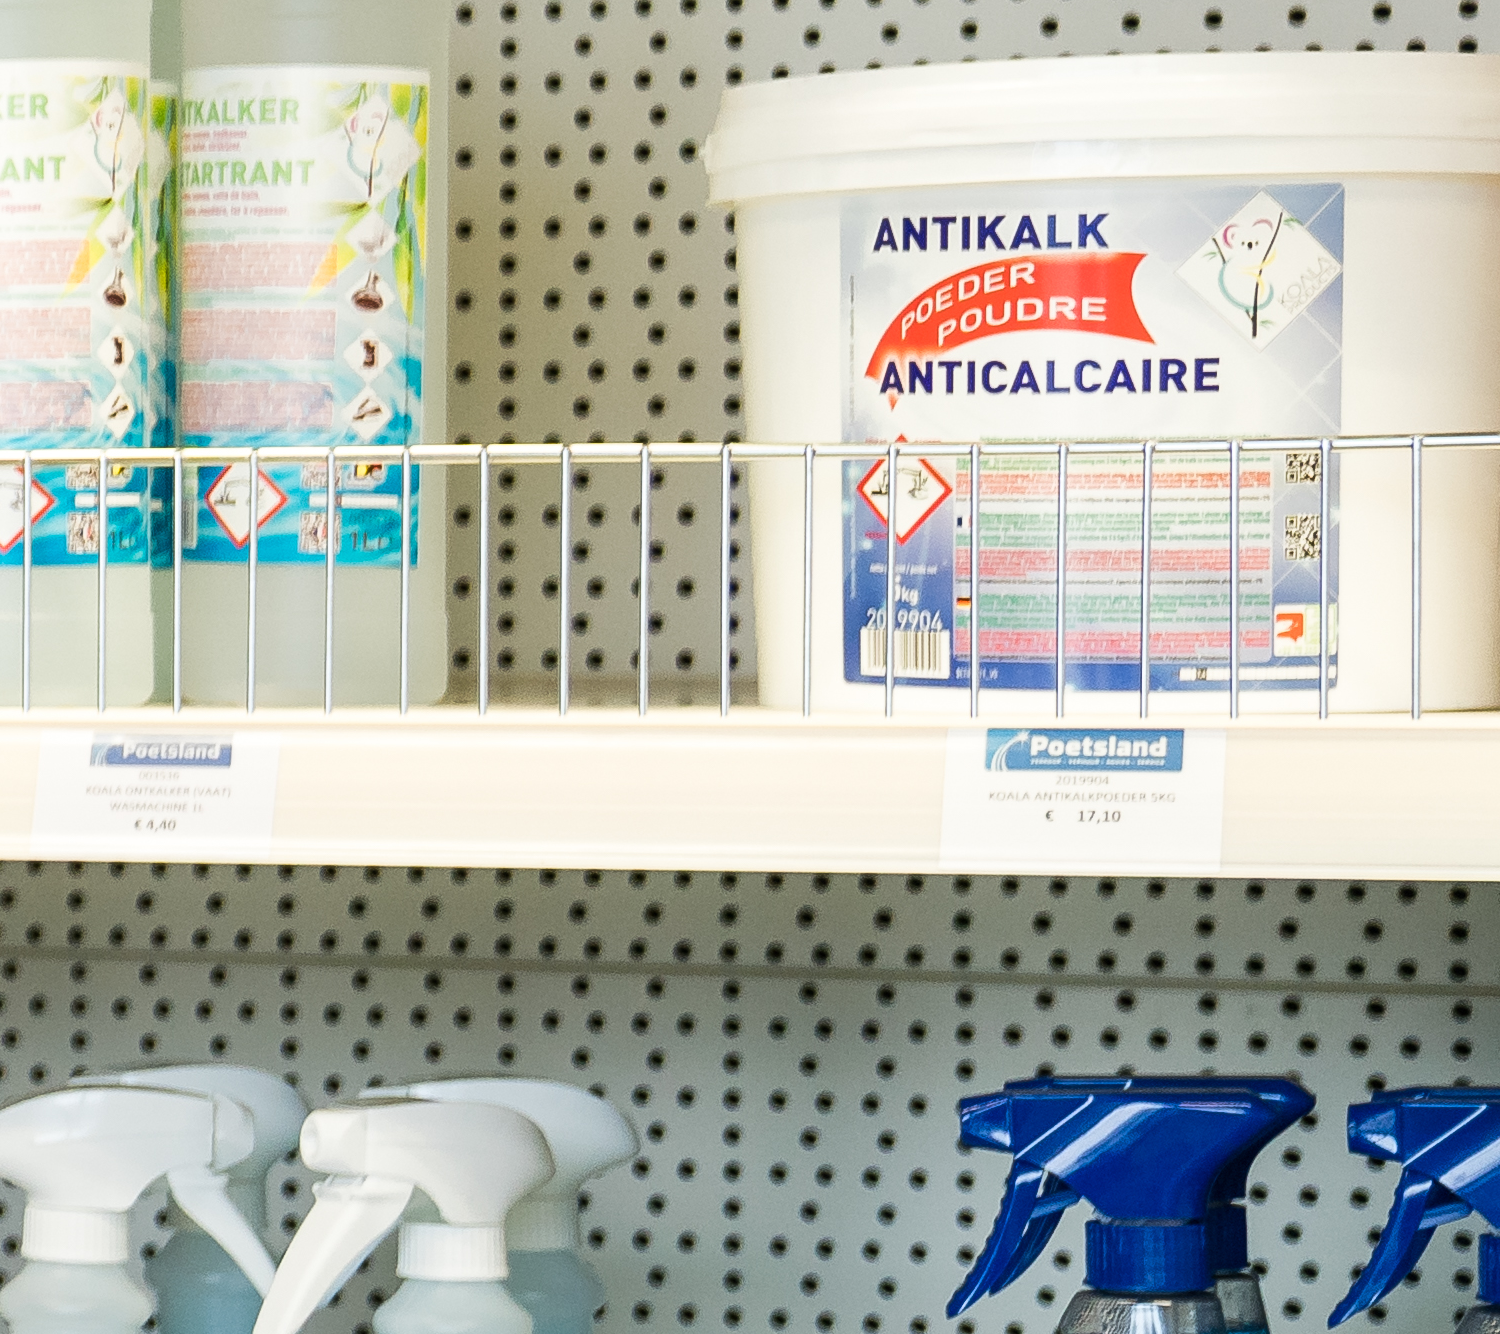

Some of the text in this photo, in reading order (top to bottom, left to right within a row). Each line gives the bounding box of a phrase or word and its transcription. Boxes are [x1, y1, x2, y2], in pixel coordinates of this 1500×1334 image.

[873, 213, 1111, 253] ANTIKALK
[900, 262, 1036, 341] POEDER
[937, 296, 1108, 347] POUDRE
[880, 357, 1220, 396] ANTICALCAIRE
[866, 607, 943, 632] 209904
[122, 742, 221, 759] Poetsland
[1031, 735, 1167, 757] Poetsland
[1056, 776, 1110, 785] 2019904
[989, 792, 1176, 803] KOALA ANTIKALKPOEDER 5KG
[146, 819, 177, 832] 4,40
[1046, 810, 1121, 824] € 17,10
